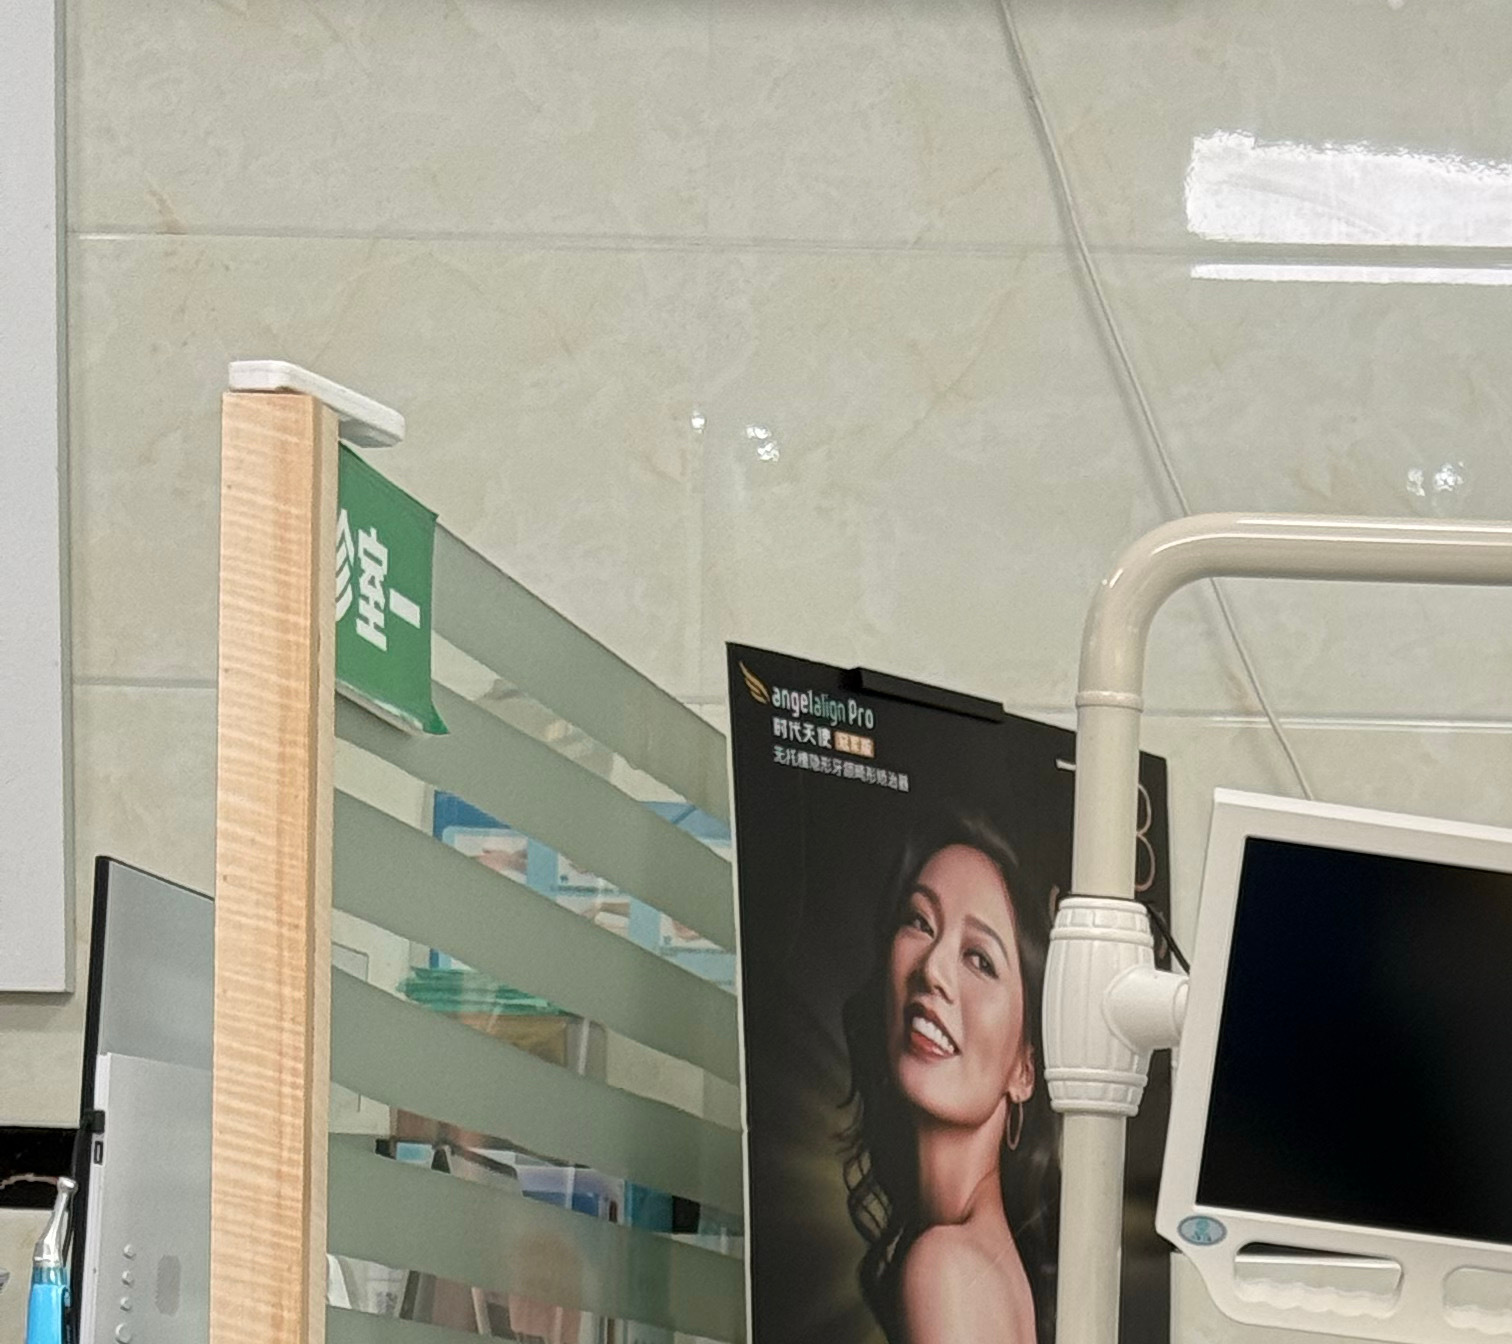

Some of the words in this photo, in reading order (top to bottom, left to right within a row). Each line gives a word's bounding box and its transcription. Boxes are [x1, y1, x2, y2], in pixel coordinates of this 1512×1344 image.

[771, 685, 847, 727] angelalign
[847, 698, 875, 730] Pro
[772, 717, 833, 750] 时代天使
